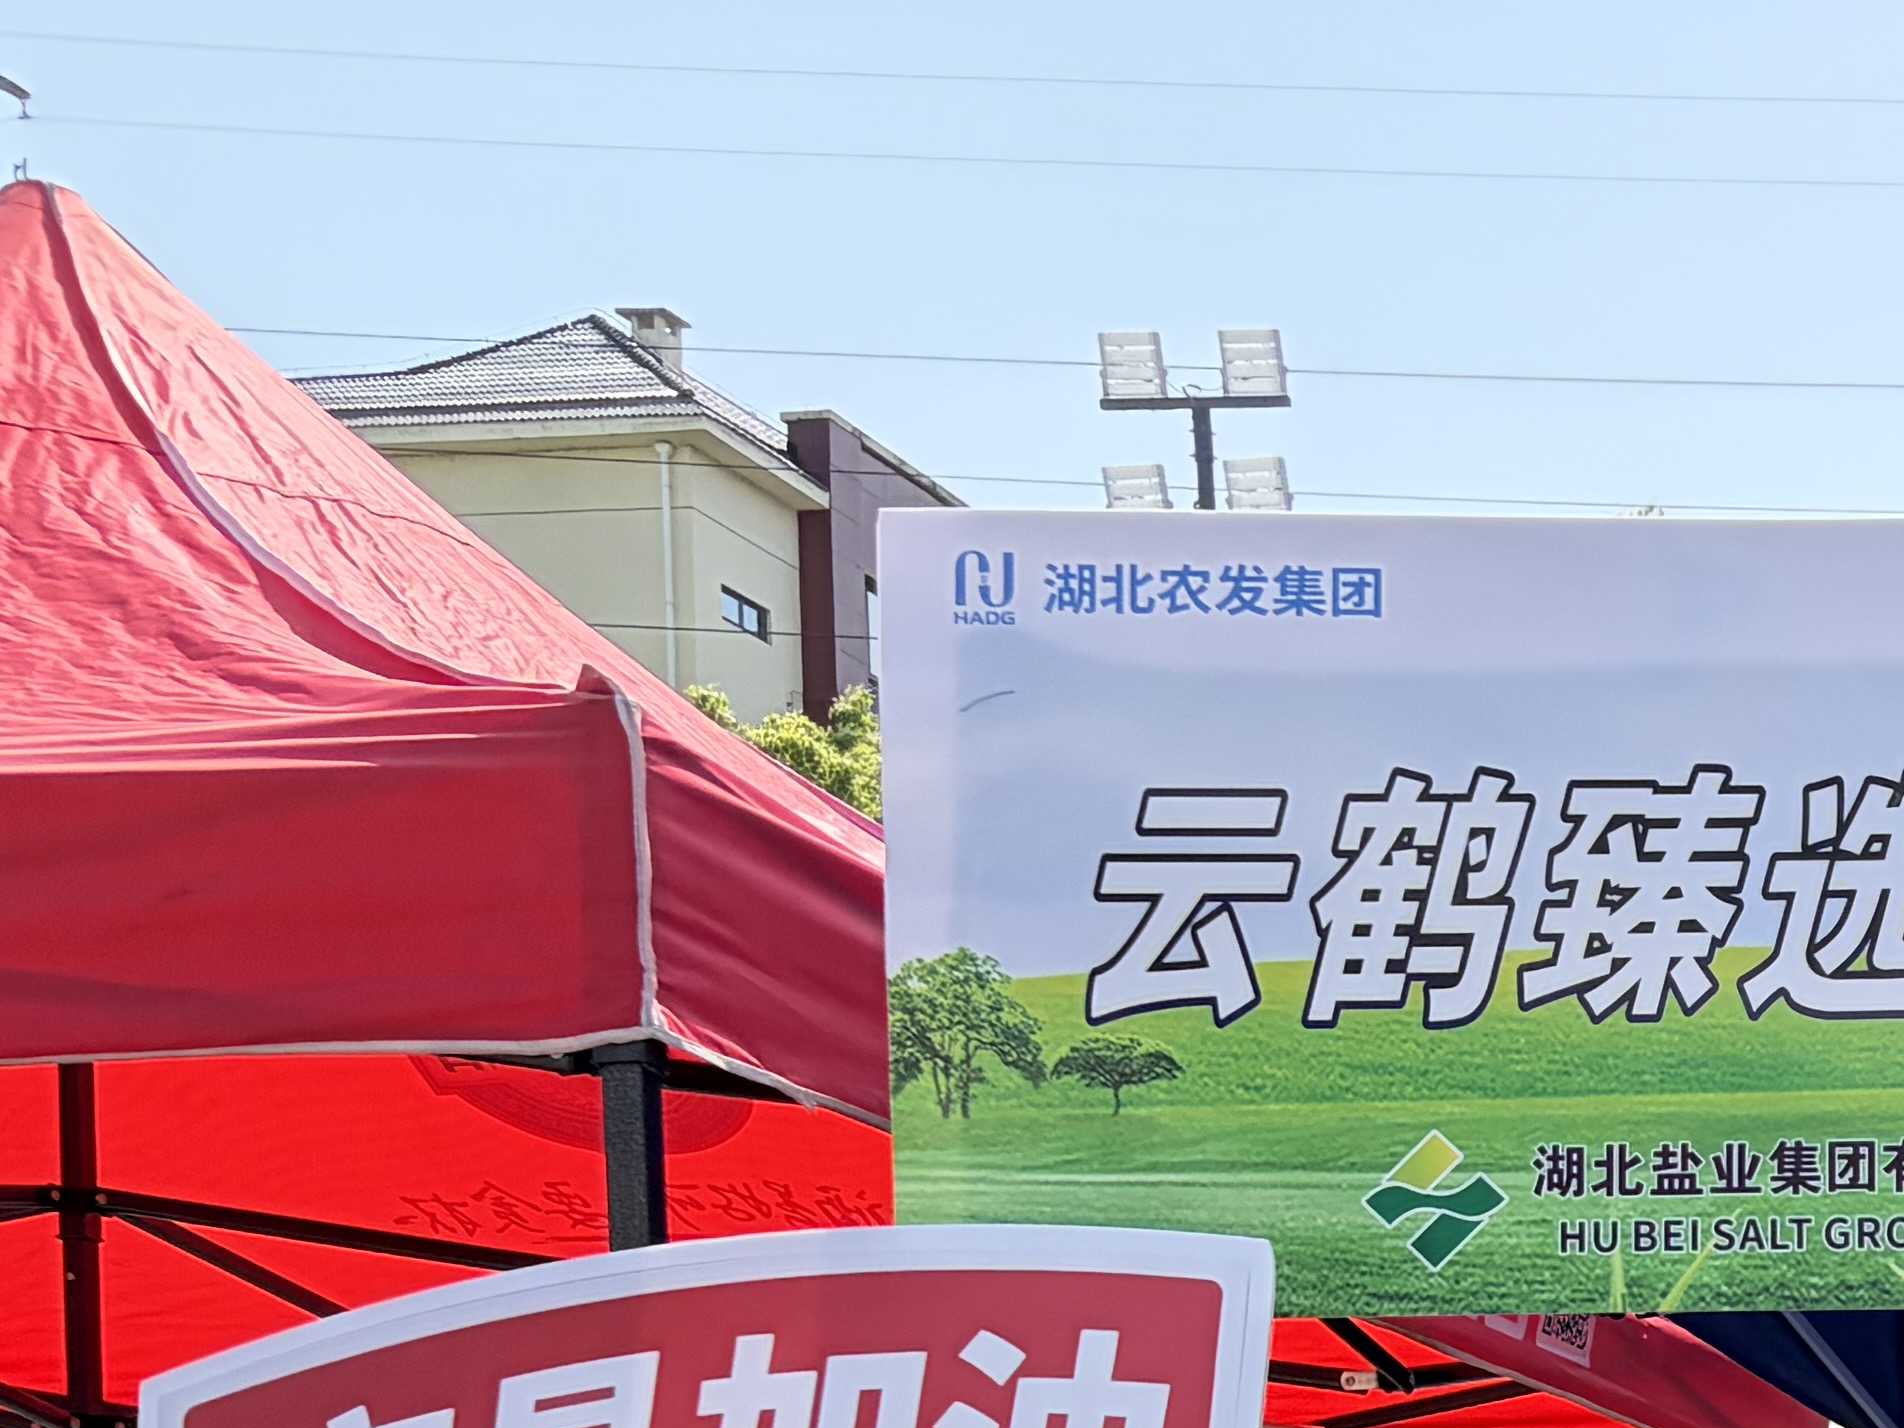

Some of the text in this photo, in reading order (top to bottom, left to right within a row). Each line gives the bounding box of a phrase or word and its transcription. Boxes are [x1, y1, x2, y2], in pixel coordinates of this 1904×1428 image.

[1043, 563, 1385, 618] 湖北农发集团
[953, 611, 1017, 626] HADG
[1712, 1216, 1814, 1251] SALT
